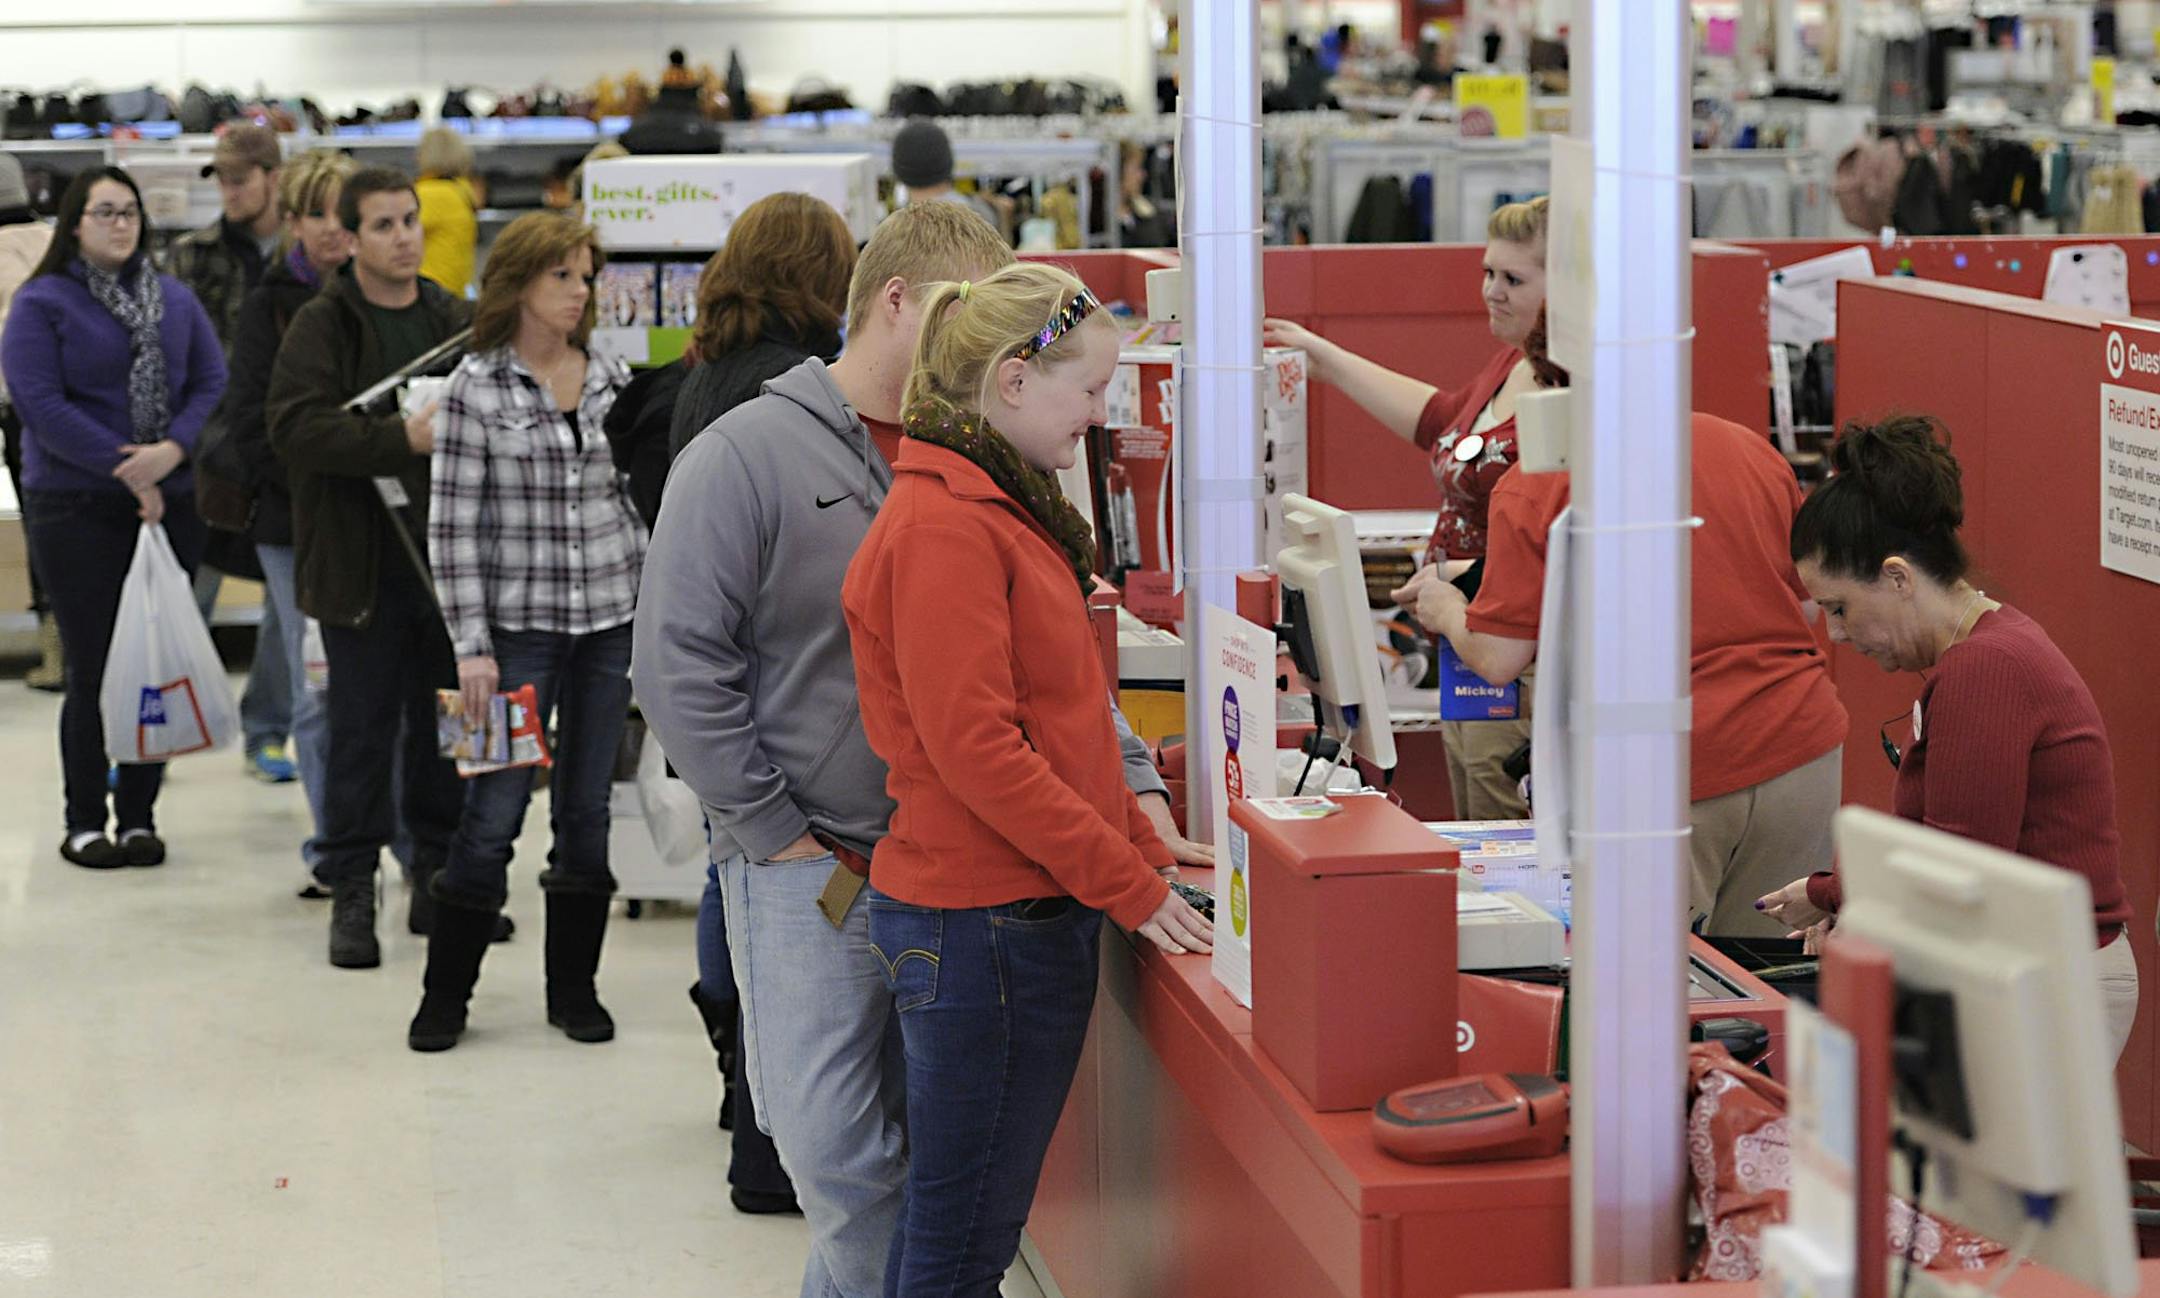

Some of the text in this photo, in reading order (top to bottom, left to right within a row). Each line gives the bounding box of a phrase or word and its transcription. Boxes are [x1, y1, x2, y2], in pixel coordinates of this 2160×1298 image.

[592, 206, 655, 222] ever.
[2128, 342, 2160, 375] Gues
[2118, 464, 2133, 481] days
[2109, 485, 2136, 502] modified
[2138, 493, 2157, 508] return
[2130, 538, 2152, 557] receipt
[1222, 648, 1256, 680] CONFIDENCE
[1455, 686, 1504, 698] Mickey
